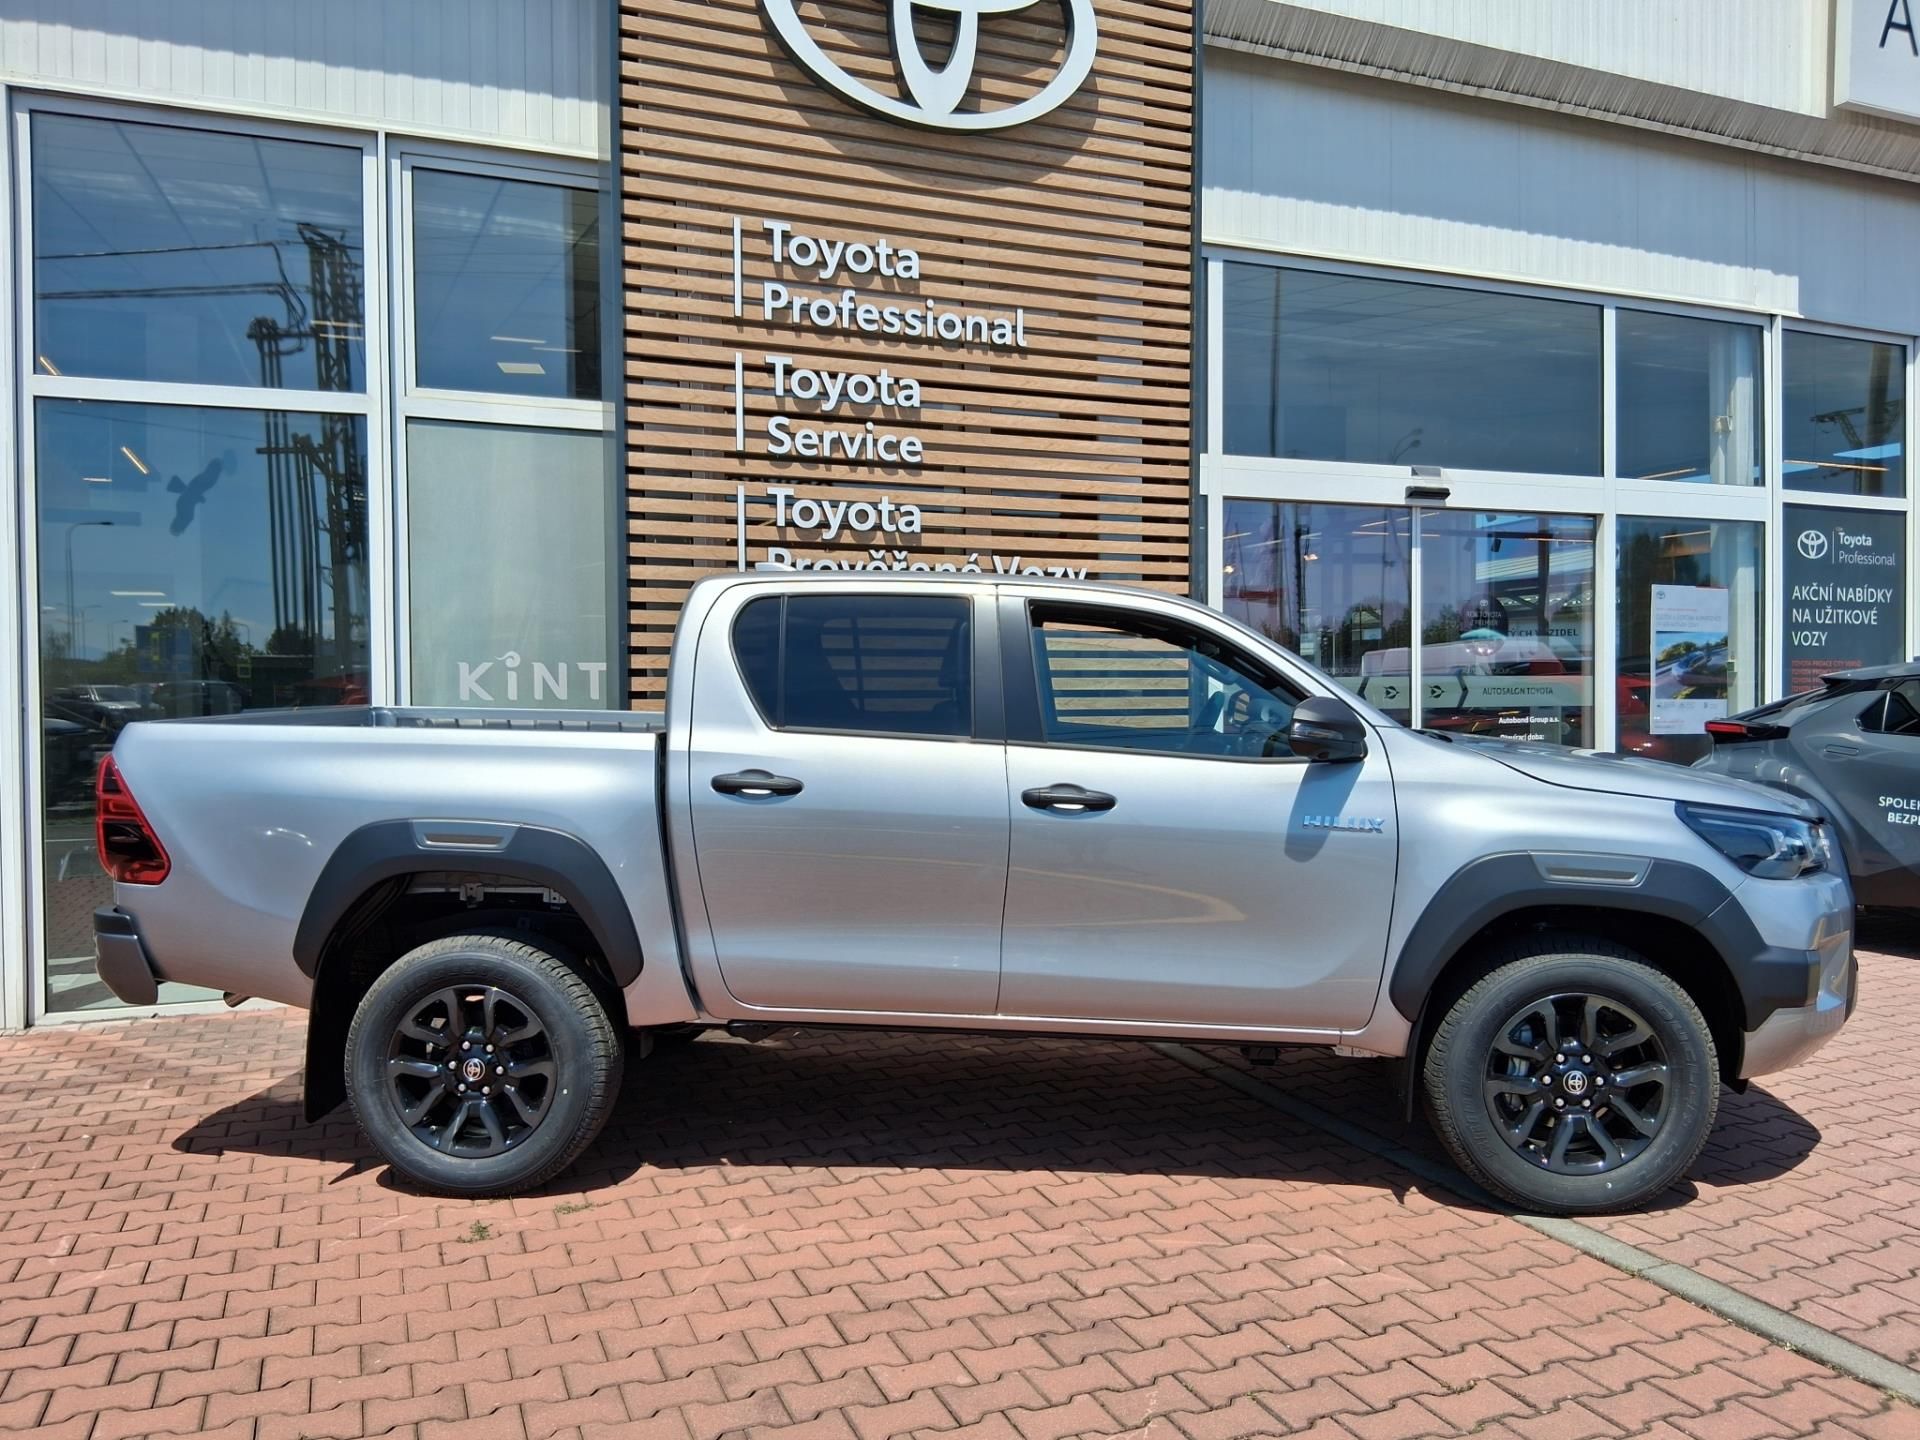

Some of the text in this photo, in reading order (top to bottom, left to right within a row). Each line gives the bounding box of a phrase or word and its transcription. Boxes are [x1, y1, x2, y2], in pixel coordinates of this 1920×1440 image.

[763, 220, 920, 279] Toyota
[763, 282, 1027, 347] Professional
[765, 354, 921, 411] Toyota
[767, 416, 923, 462] Service
[767, 487, 921, 540] Toyota
[1838, 531, 1873, 548] Toyota
[1838, 551, 1896, 567] Professional
[1792, 582, 1893, 603] AKČNÍ NABÍDKY
[1792, 605, 1878, 625] NA UŽITKOVÉ
[1792, 631, 1828, 646] VOZY
[1482, 687, 1553, 695] AUTOSALON TOYOTA
[1498, 716, 1529, 724] Autobond
[1530, 716, 1549, 725] Group
